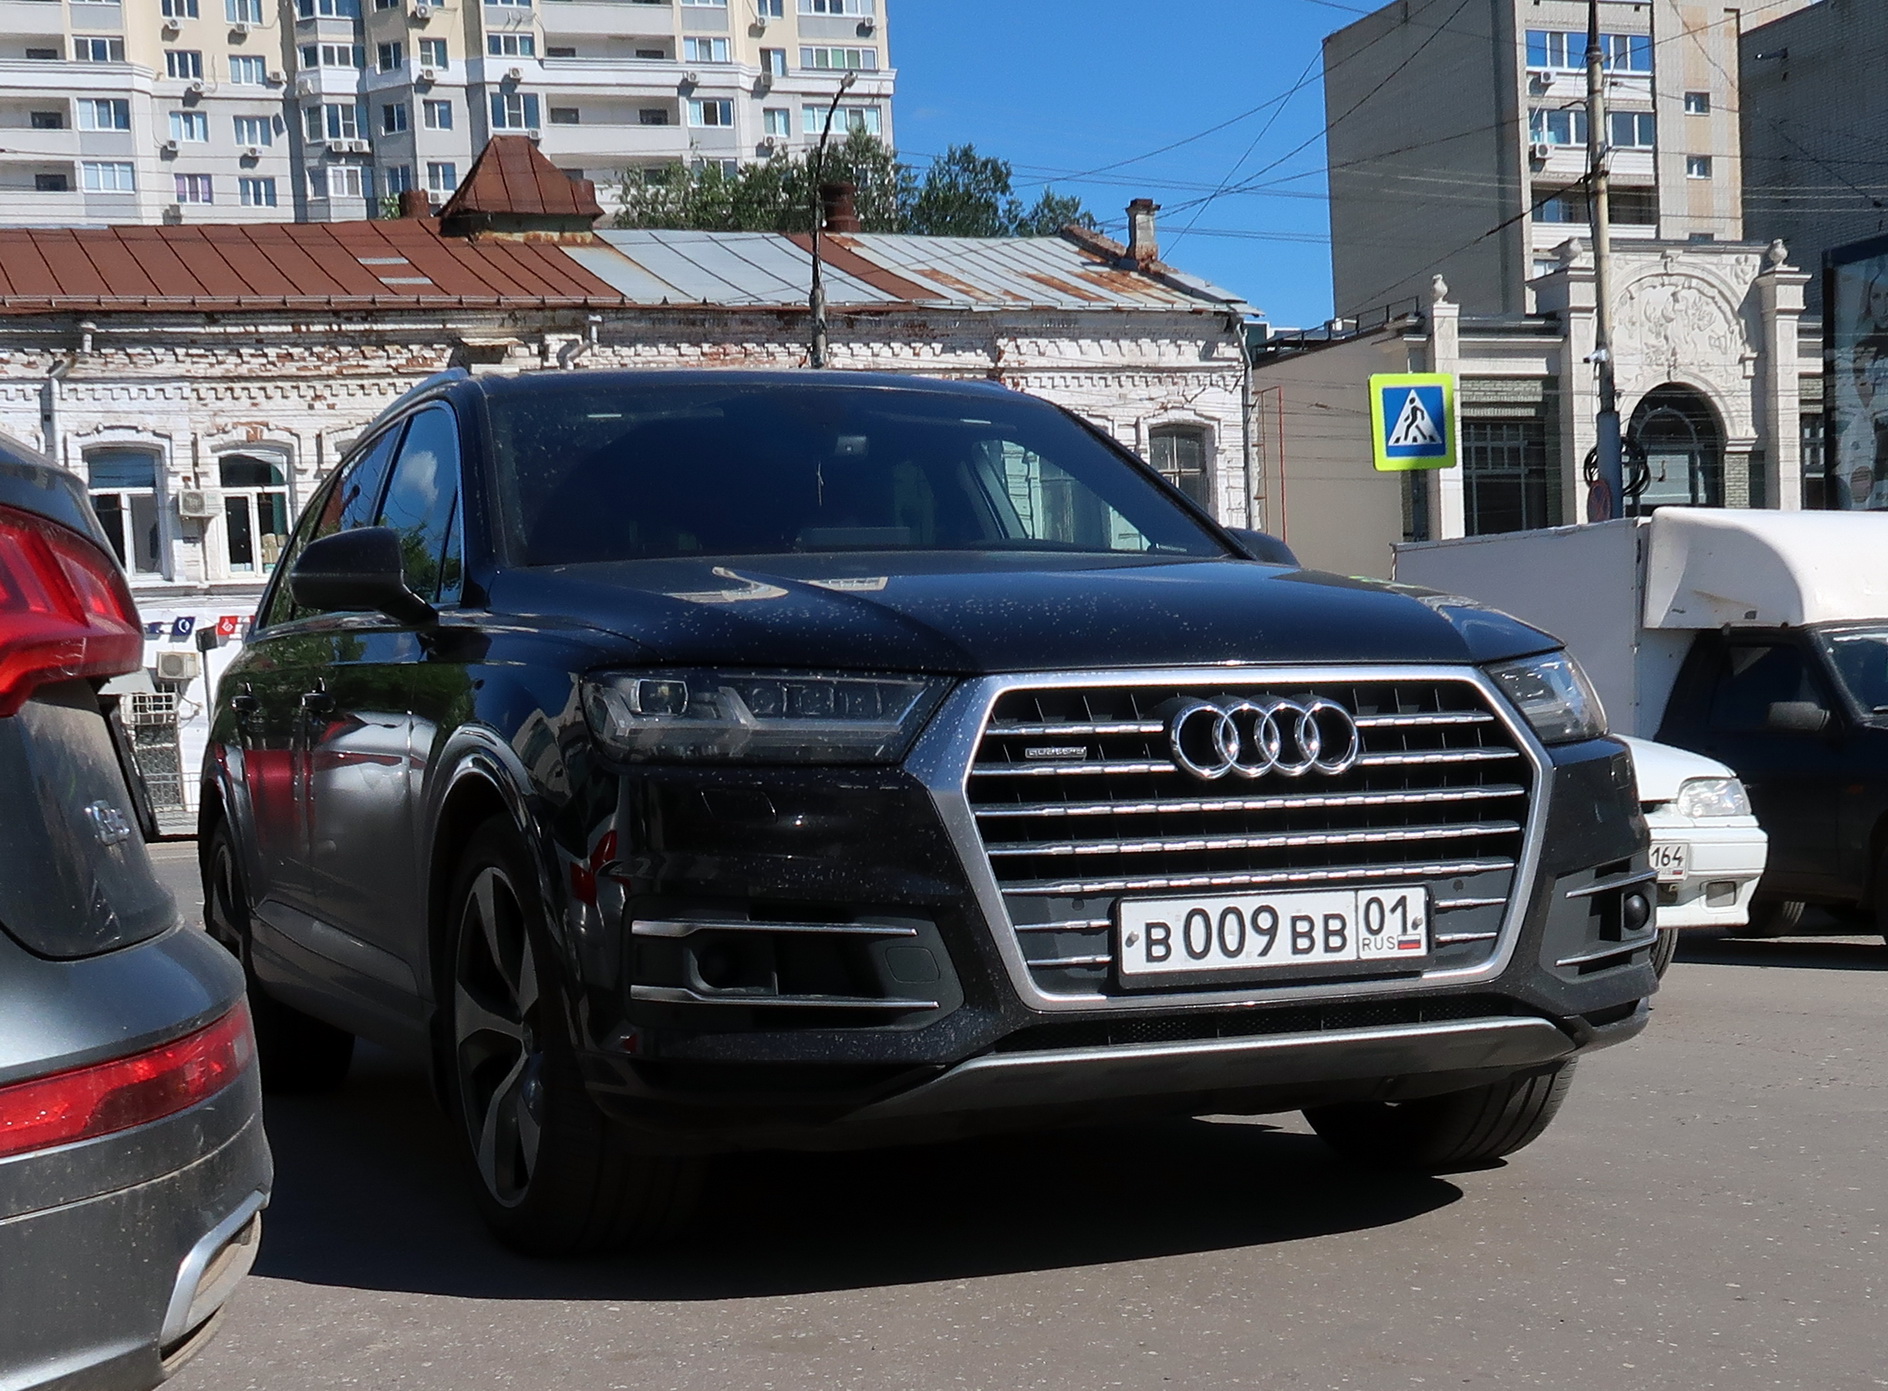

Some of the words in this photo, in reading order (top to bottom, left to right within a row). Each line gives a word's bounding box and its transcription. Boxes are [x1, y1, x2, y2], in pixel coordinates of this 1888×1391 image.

[1651, 845, 1683, 867] 164
[1364, 895, 1408, 936] 01
[1362, 935, 1396, 951] RUS
